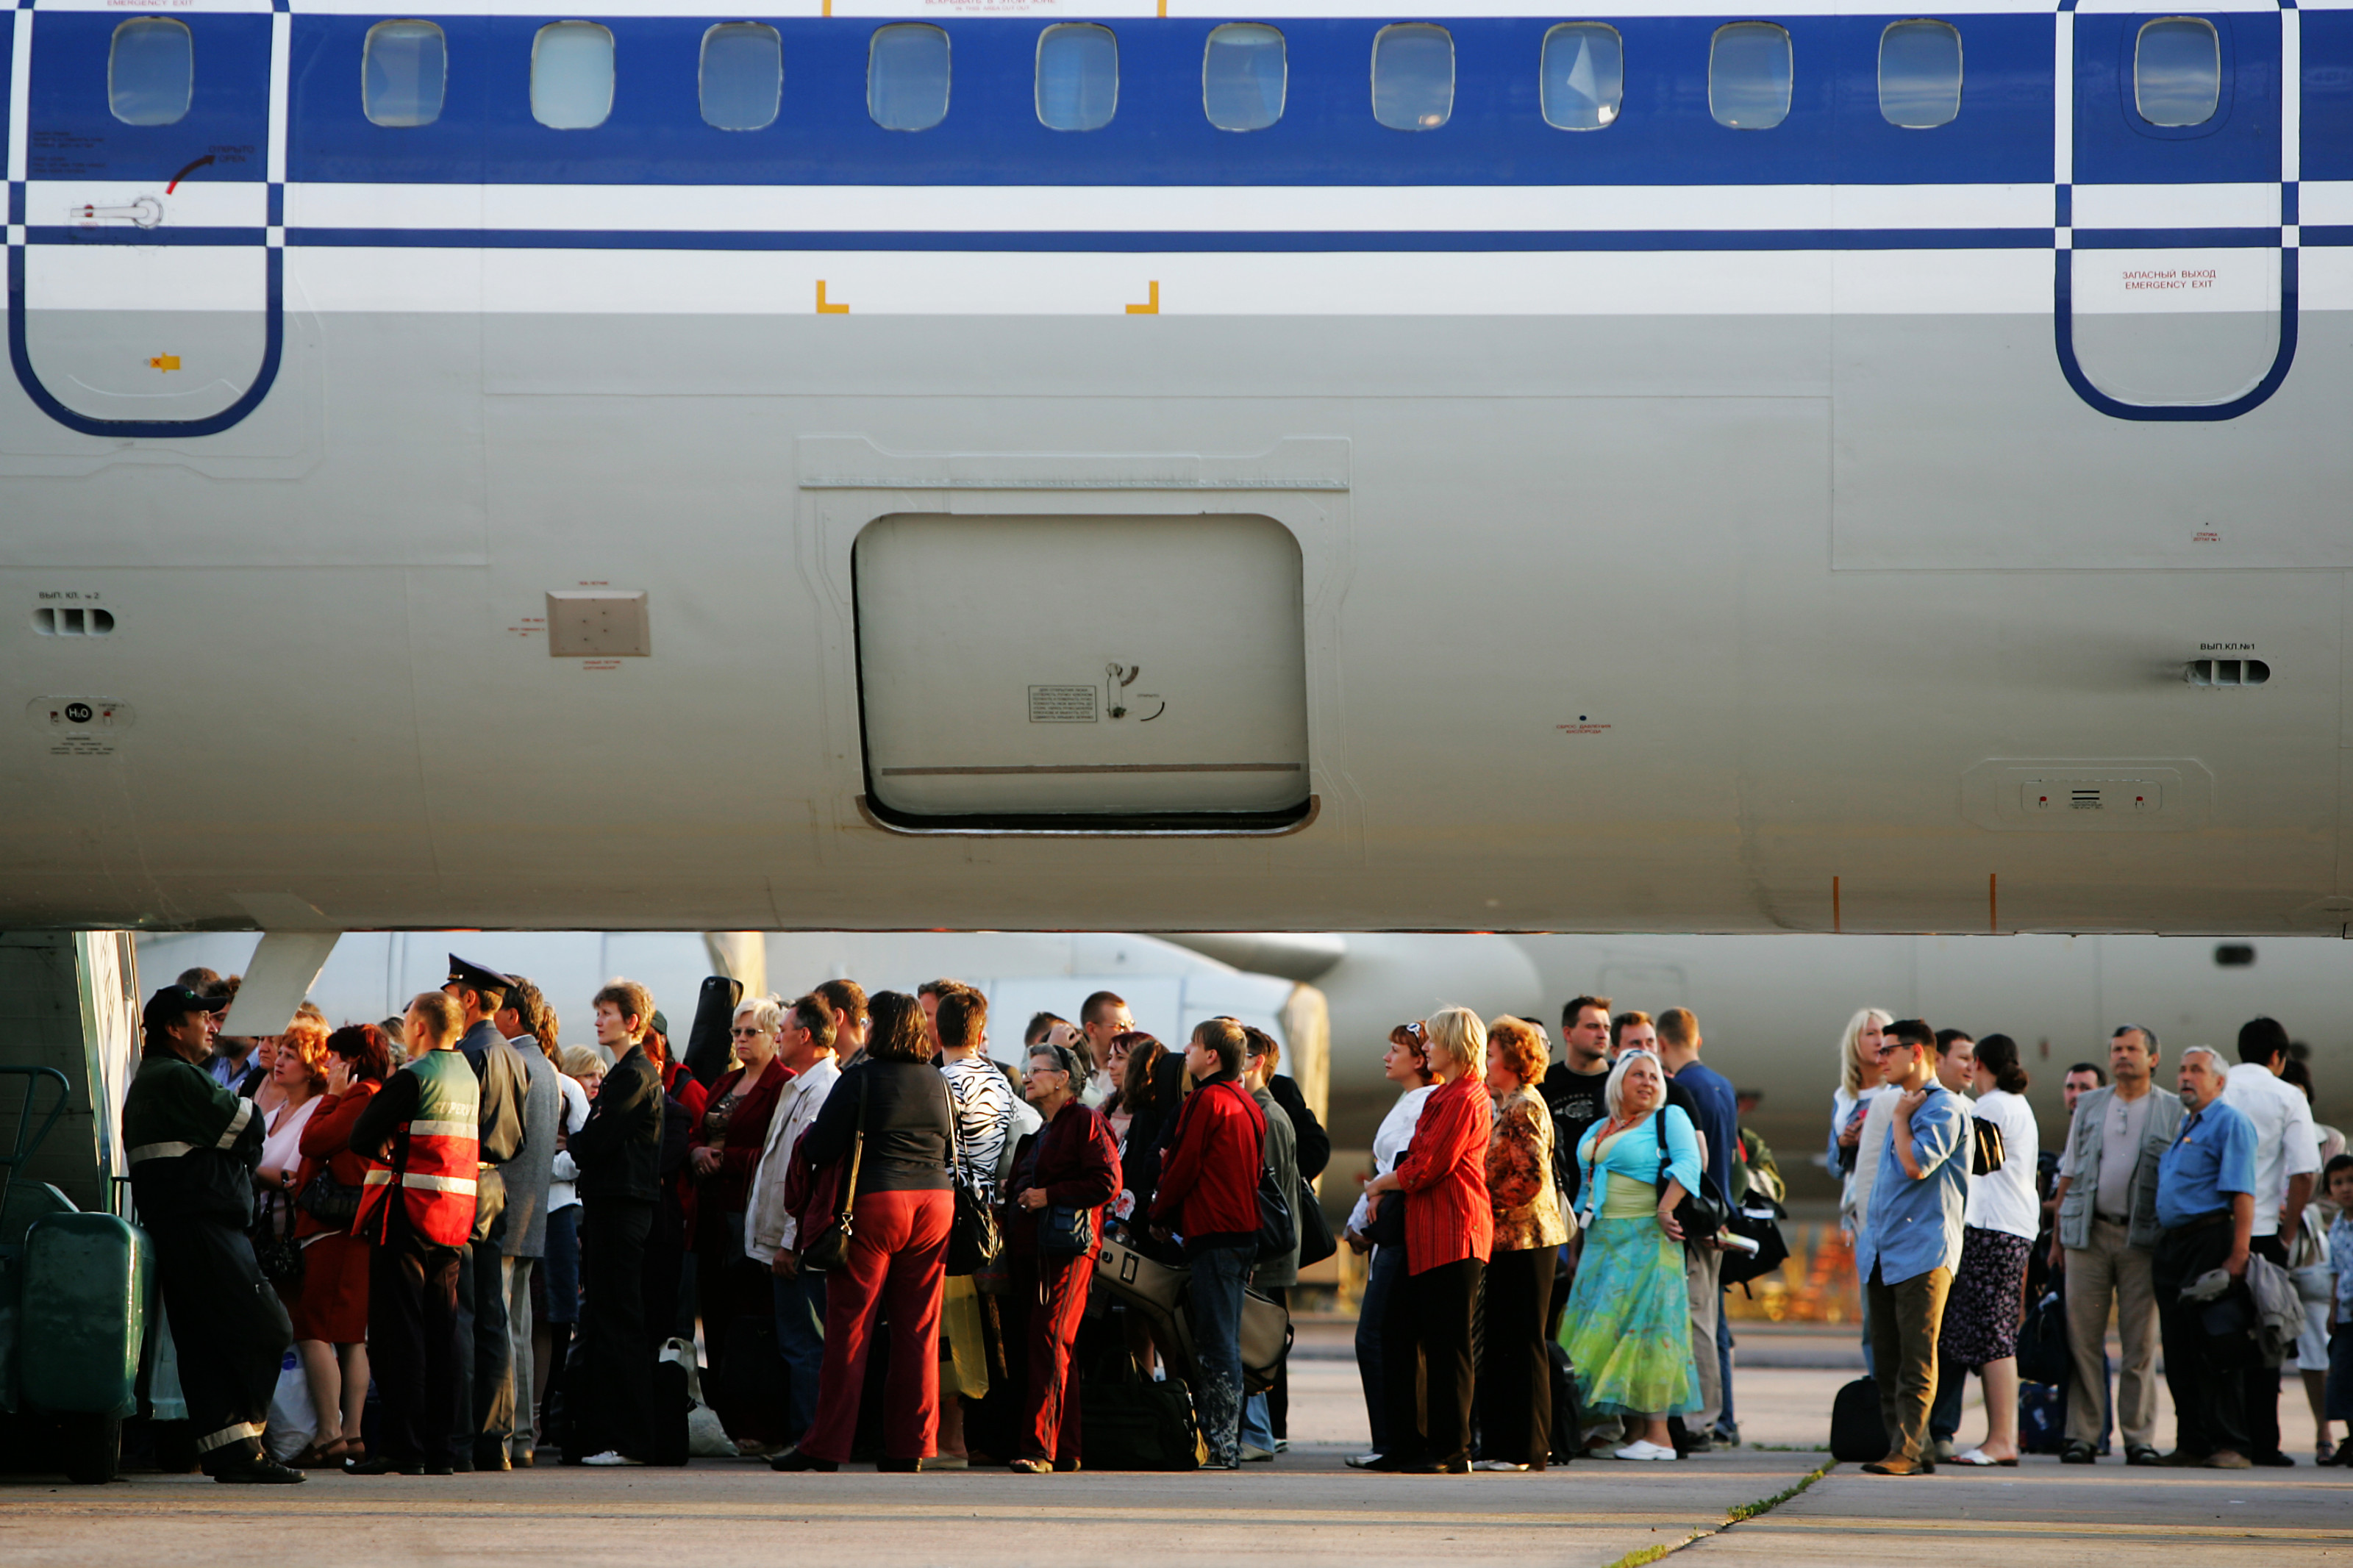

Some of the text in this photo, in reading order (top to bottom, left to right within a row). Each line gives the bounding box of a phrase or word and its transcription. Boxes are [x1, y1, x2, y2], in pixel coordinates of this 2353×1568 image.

[2122, 269, 2217, 280] ЗАПАСНЫЙ ВЫХОД
[2125, 279, 2213, 290] EMERGENCY EXIT
